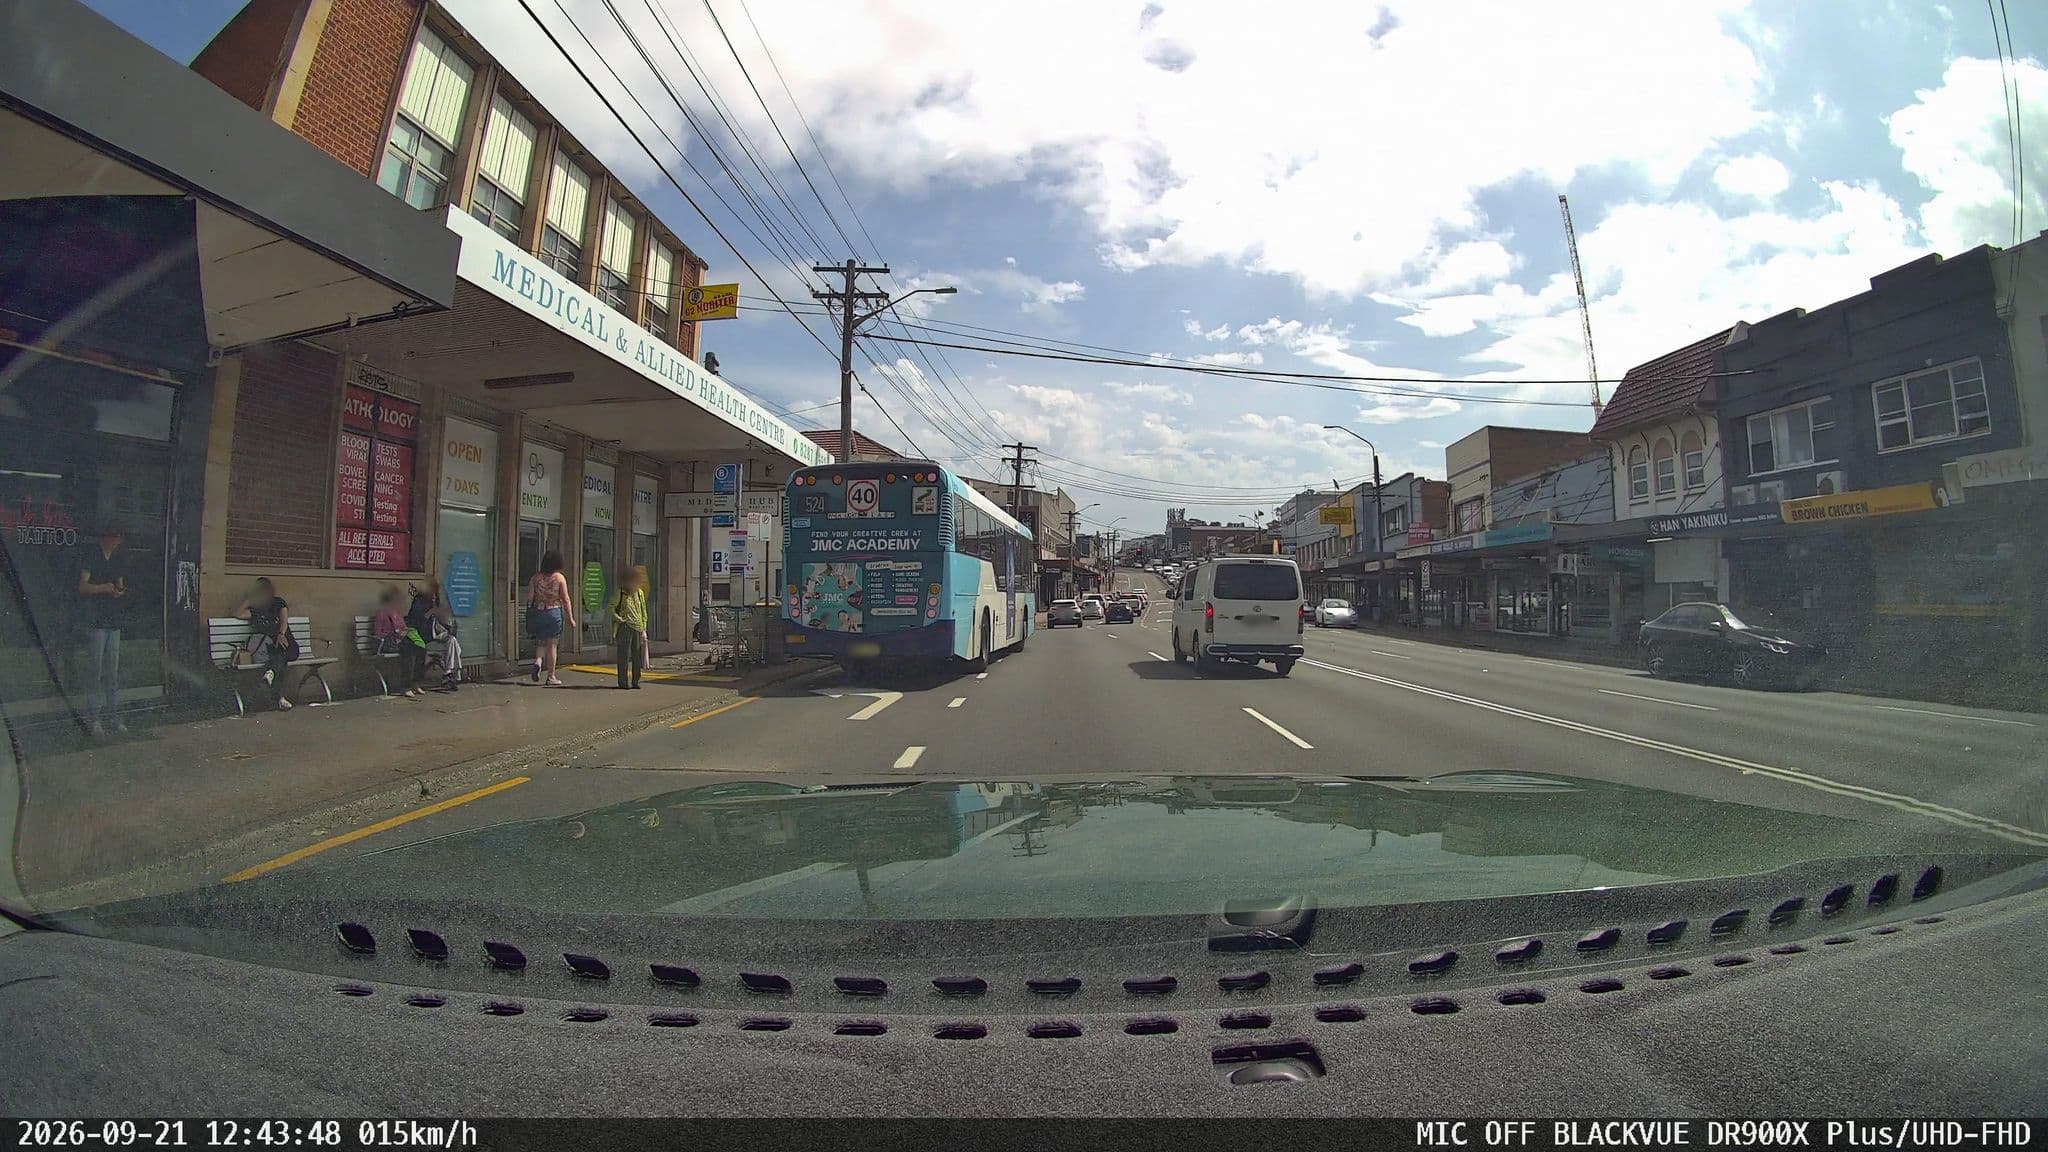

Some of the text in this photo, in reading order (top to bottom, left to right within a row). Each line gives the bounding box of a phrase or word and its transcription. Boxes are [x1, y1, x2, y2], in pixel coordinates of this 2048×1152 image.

[492, 250, 608, 342] MEDICAL
[616, 328, 627, 353] &
[635, 339, 695, 391] ALLIED
[700, 378, 746, 423] HEALTH
[750, 409, 785, 445] CENTRE
[345, 398, 414, 429] ATHOLOGY
[341, 435, 398, 457] BLOOD TESTS
[447, 440, 482, 464] OPEN
[346, 450, 401, 469] VIRAL SWABS
[340, 464, 404, 485] BOWEL CANCER
[446, 476, 480, 495] 7 DAYS
[584, 475, 611, 496] EDICAL
[341, 493, 398, 512] COVID Testing
[522, 492, 548, 509] ENTRY
[634, 487, 652, 504] NTRE
[805, 496, 825, 513] 524
[851, 488, 875, 504] 40
[353, 509, 398, 526] STI Testing
[594, 506, 611, 520] NOW
[1792, 507, 1826, 521] BROWN
[1828, 502, 1869, 518] CHICKEN
[1660, 520, 1681, 533] HAN
[1681, 512, 1728, 529] YAKINIKU
[17, 525, 77, 546] TATTOO
[338, 531, 351, 545] ALL
[832, 530, 849, 538] YOUR
[810, 538, 921, 551] JMC ACADEMY
[822, 593, 843, 602] JMC
